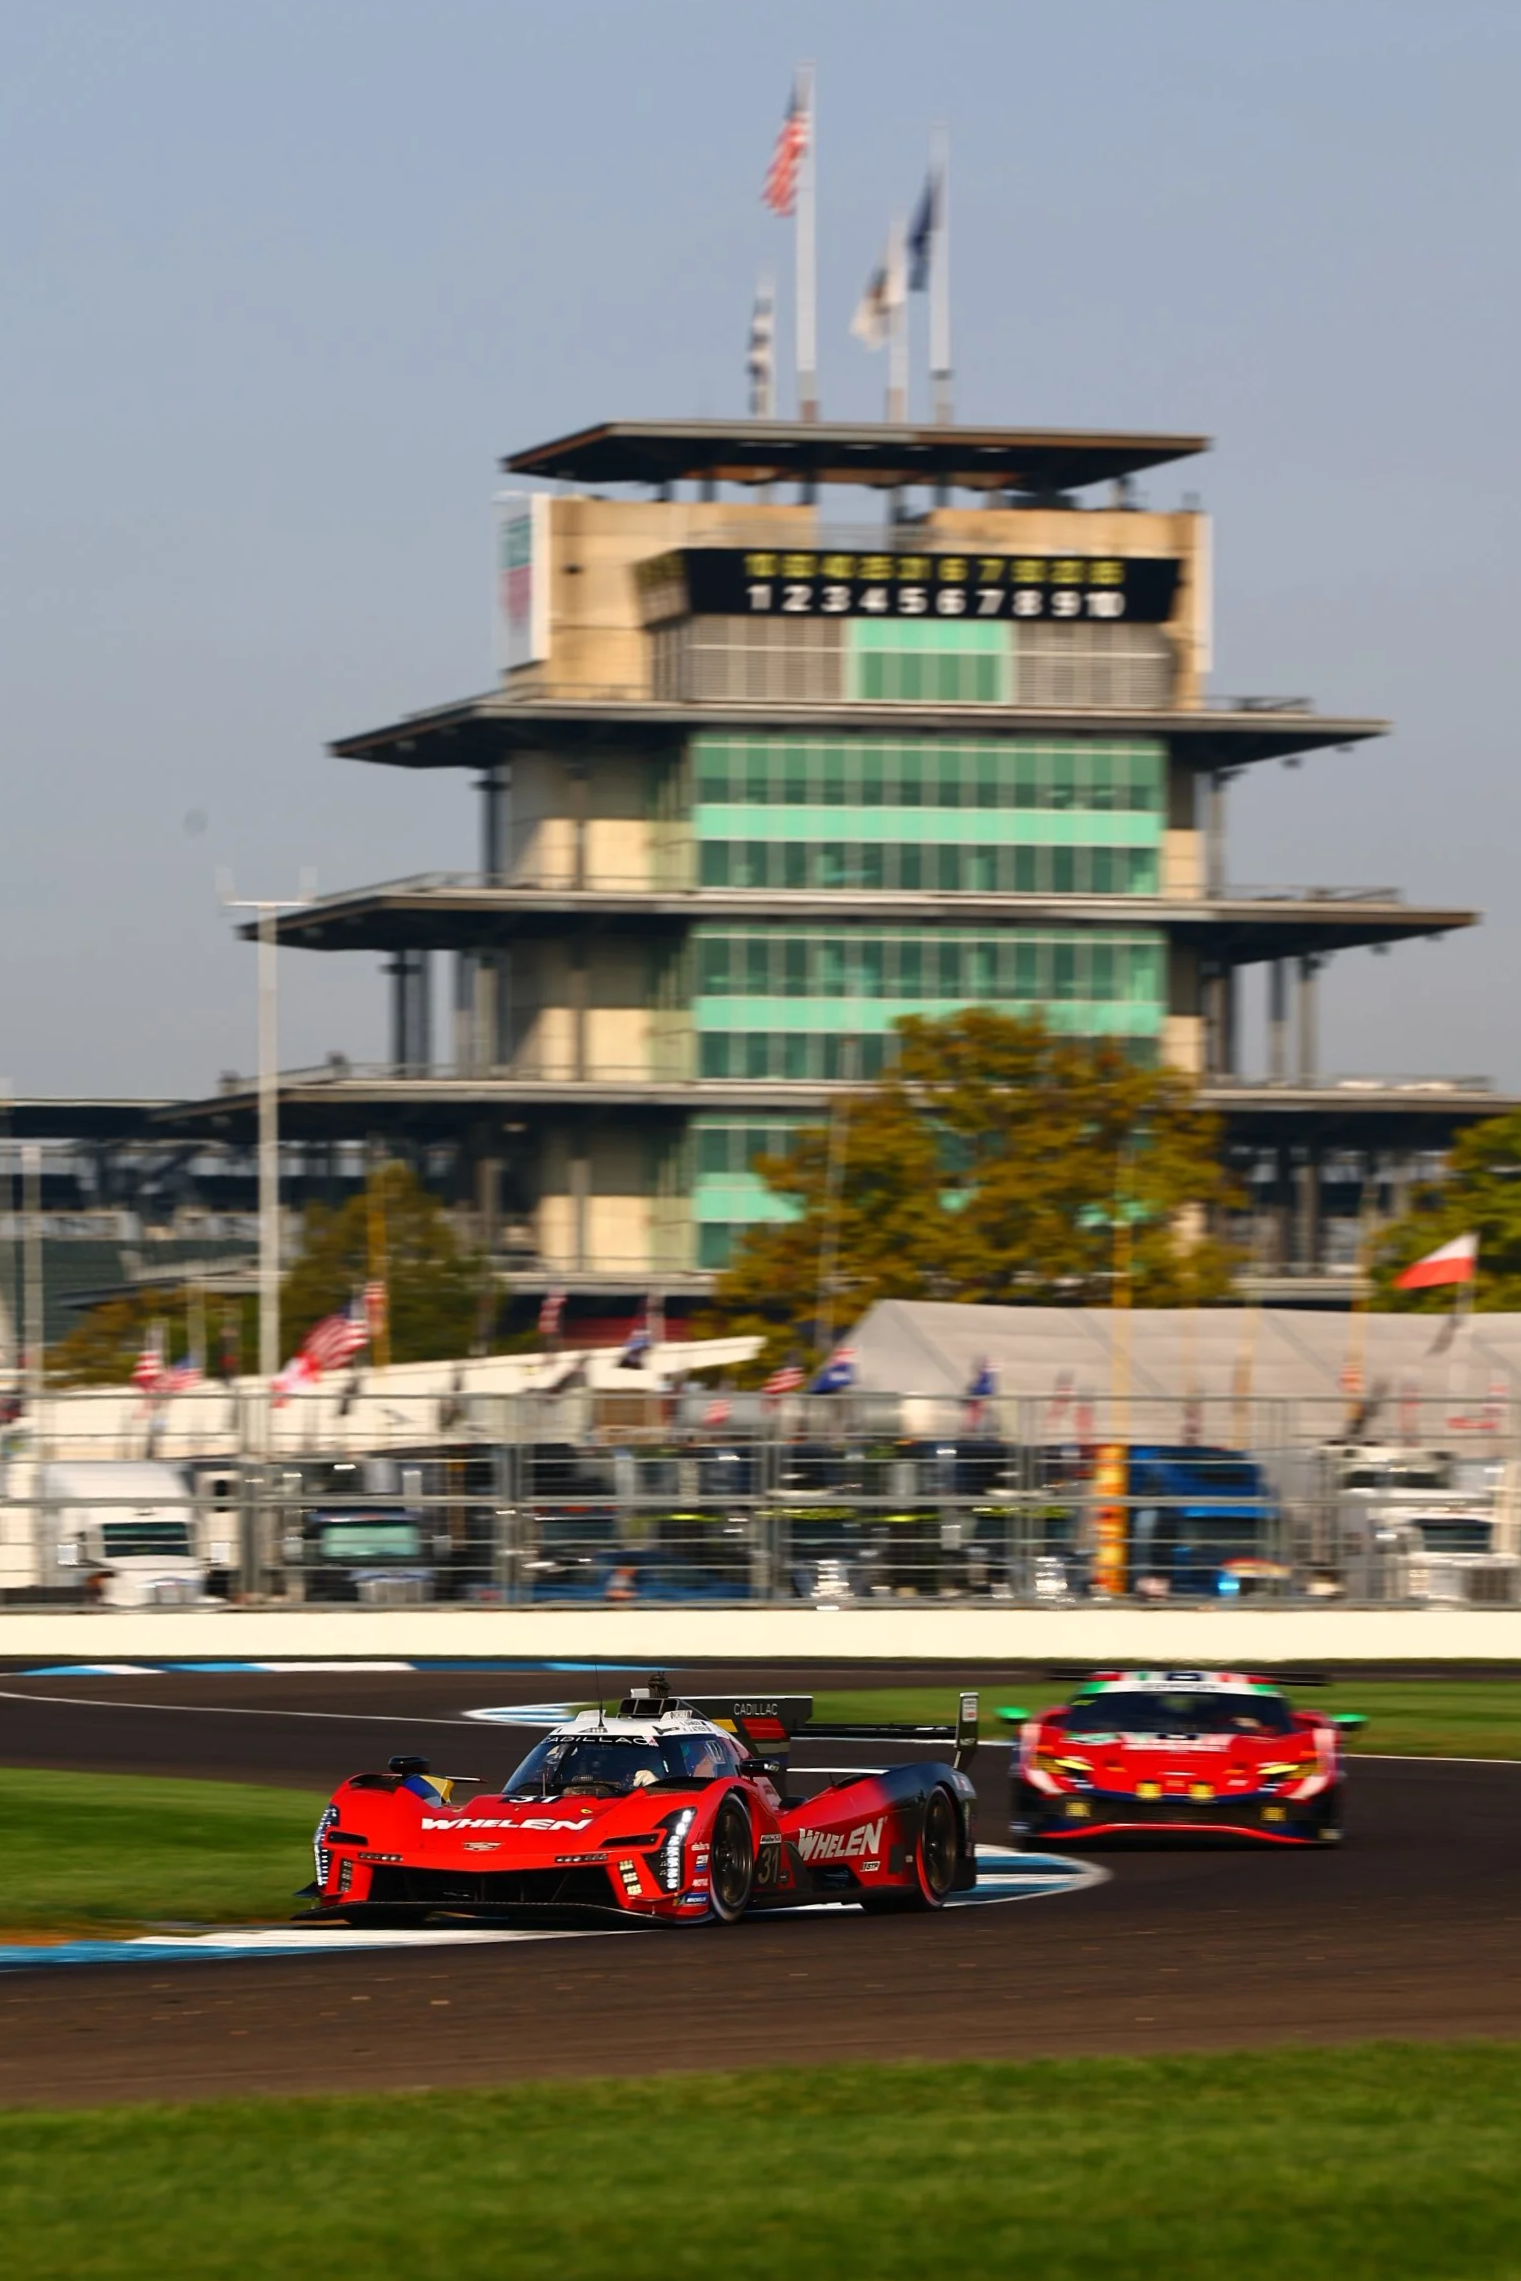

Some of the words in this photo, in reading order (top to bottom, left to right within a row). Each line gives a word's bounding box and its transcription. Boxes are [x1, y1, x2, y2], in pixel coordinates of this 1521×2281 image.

[976, 558, 1005, 581] 7
[745, 584, 772, 611] 1
[781, 584, 813, 612] 2
[820, 585, 851, 613] 3
[858, 587, 889, 613] 4
[898, 587, 928, 614] 5
[936, 588, 966, 614] 6
[975, 589, 1005, 614] 7
[1012, 590, 1043, 616] 8
[1051, 591, 1081, 617] 9
[1085, 591, 1126, 617] 10
[733, 1703, 778, 1715] CADILLAC
[541, 1736, 649, 1745] CADILLAC
[421, 1817, 592, 1831] WHELEN
[799, 1815, 884, 1862] WHELEN
[758, 1847, 780, 1884] 31
